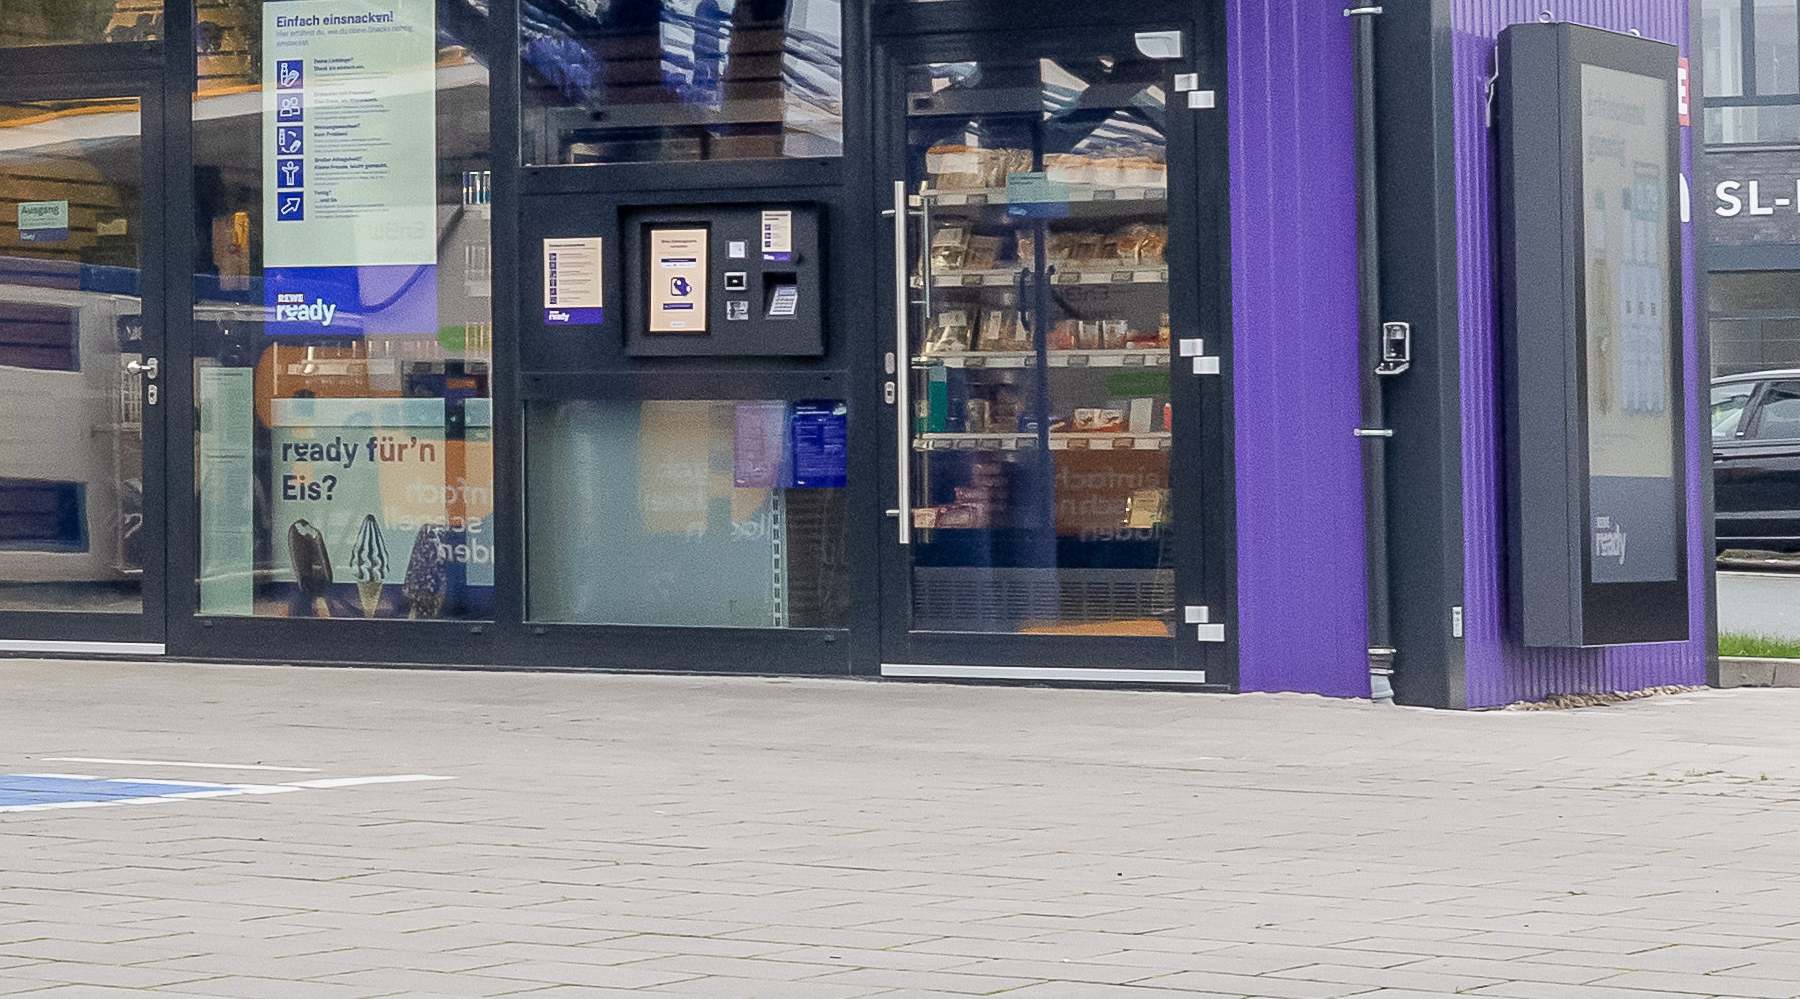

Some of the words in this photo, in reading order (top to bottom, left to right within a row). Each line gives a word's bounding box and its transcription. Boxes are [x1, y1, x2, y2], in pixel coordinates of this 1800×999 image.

[276, 14, 320, 28] Einfach
[322, 10, 394, 25] einsnacken!
[21, 204, 60, 216] Ausgang
[276, 298, 336, 327] ready
[282, 436, 358, 468] ready
[366, 436, 436, 462] für’n
[282, 474, 337, 500] Eis?
[1596, 523, 1627, 565] ready
